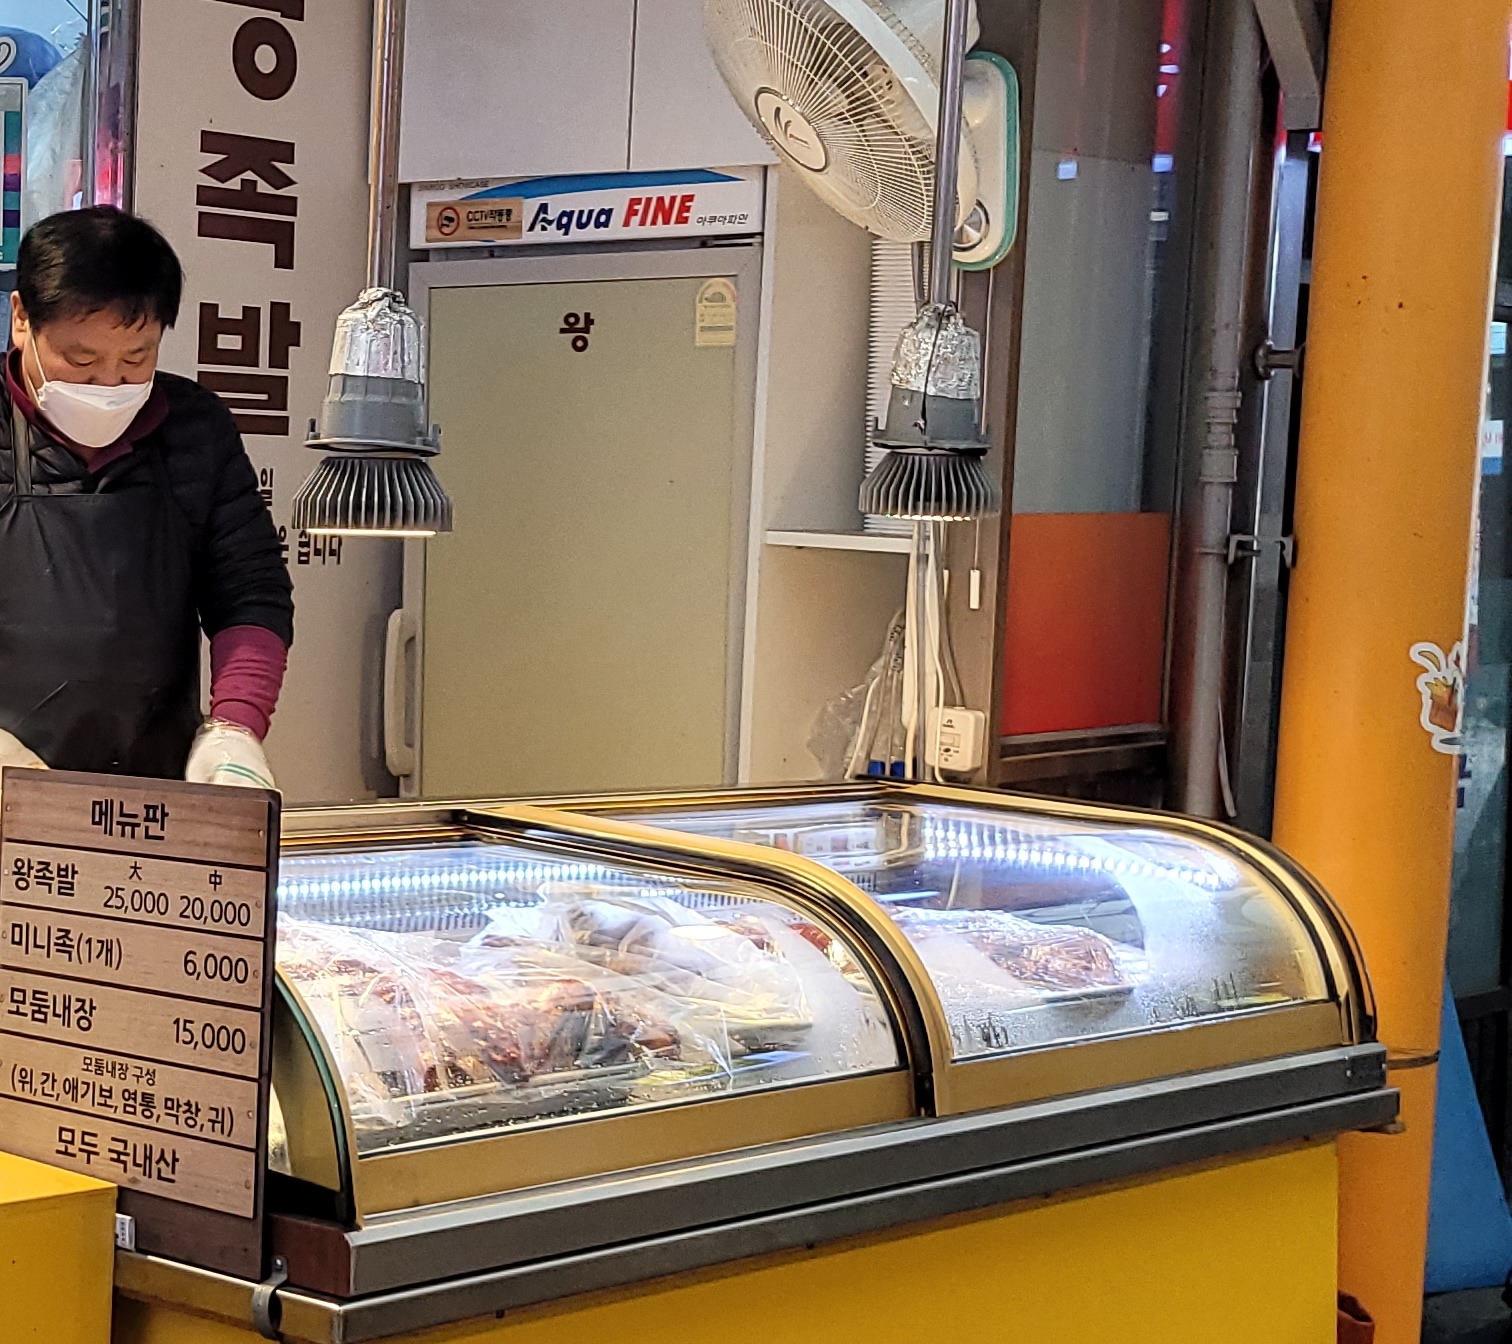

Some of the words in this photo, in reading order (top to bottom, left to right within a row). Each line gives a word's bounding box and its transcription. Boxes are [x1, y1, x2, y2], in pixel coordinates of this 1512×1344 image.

[527, 202, 614, 236] Aqua
[622, 194, 695, 228] FINE
[696, 213, 749, 226] 아쿠아파인
[559, 311, 594, 352] 왕
[90, 797, 170, 841] 메뉴판
[11, 857, 79, 898] 왕족발
[102, 886, 170, 917] 25,000
[179, 895, 252, 928] 20,000
[129, 861, 143, 882] 大
[208, 869, 224, 892] 中
[10, 920, 124, 972] 미니족(1개)
[183, 950, 250, 986] 6,000
[7, 984, 97, 1033] 모둠내장
[172, 1017, 247, 1056] 15,000
[81, 1054, 129, 1081] 모둠내장
[131, 1064, 156, 1086] 구성
[55, 1126, 101, 1165] 모두
[107, 1136, 180, 1184] 국내산
